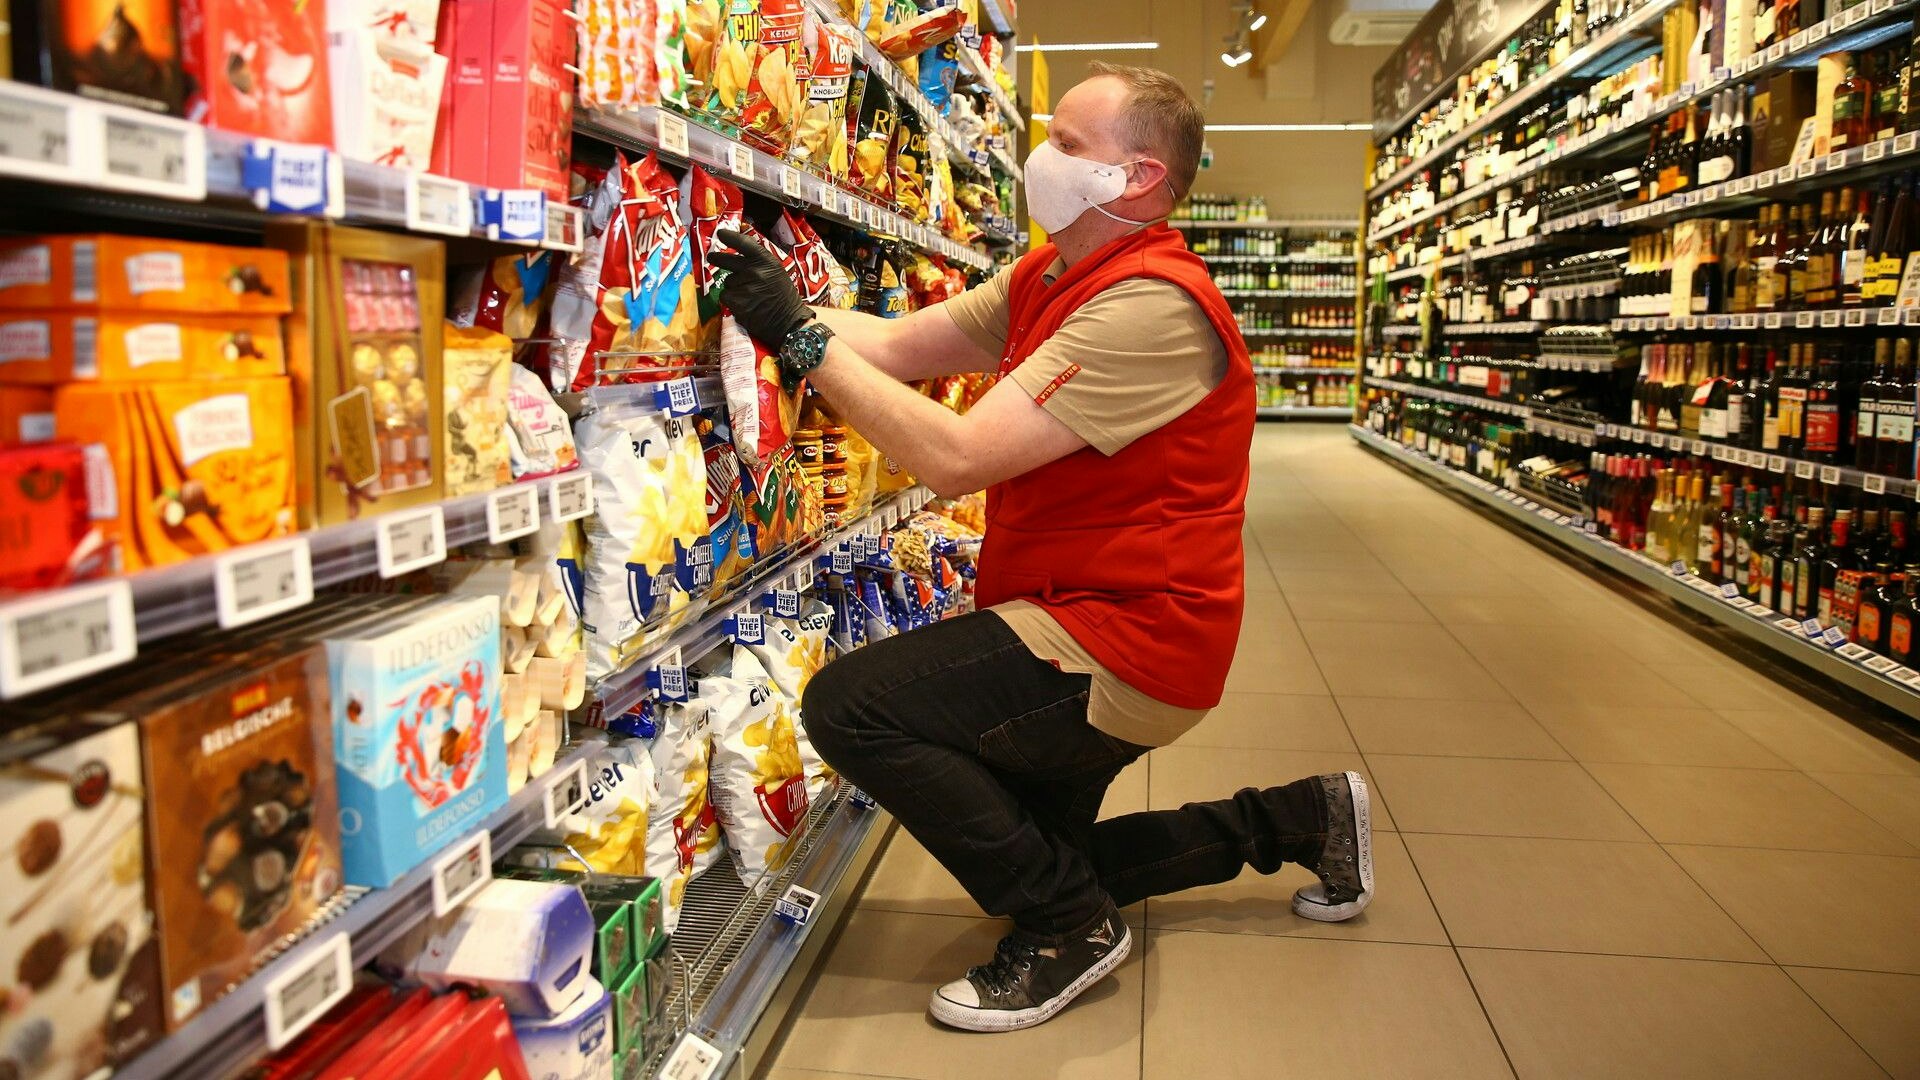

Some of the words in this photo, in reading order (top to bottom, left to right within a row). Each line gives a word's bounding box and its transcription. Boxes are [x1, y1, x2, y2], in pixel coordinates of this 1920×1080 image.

[734, 14, 758, 41] CHI
[670, 382, 689, 391] DAUER
[672, 388, 691, 399] TIEF
[674, 397, 693, 407] PREIS
[740, 623, 759, 631] TIEF
[388, 608, 494, 675] ILDEFONSO
[663, 675, 682, 684] TIEF
[664, 684, 683, 692] PREIS
